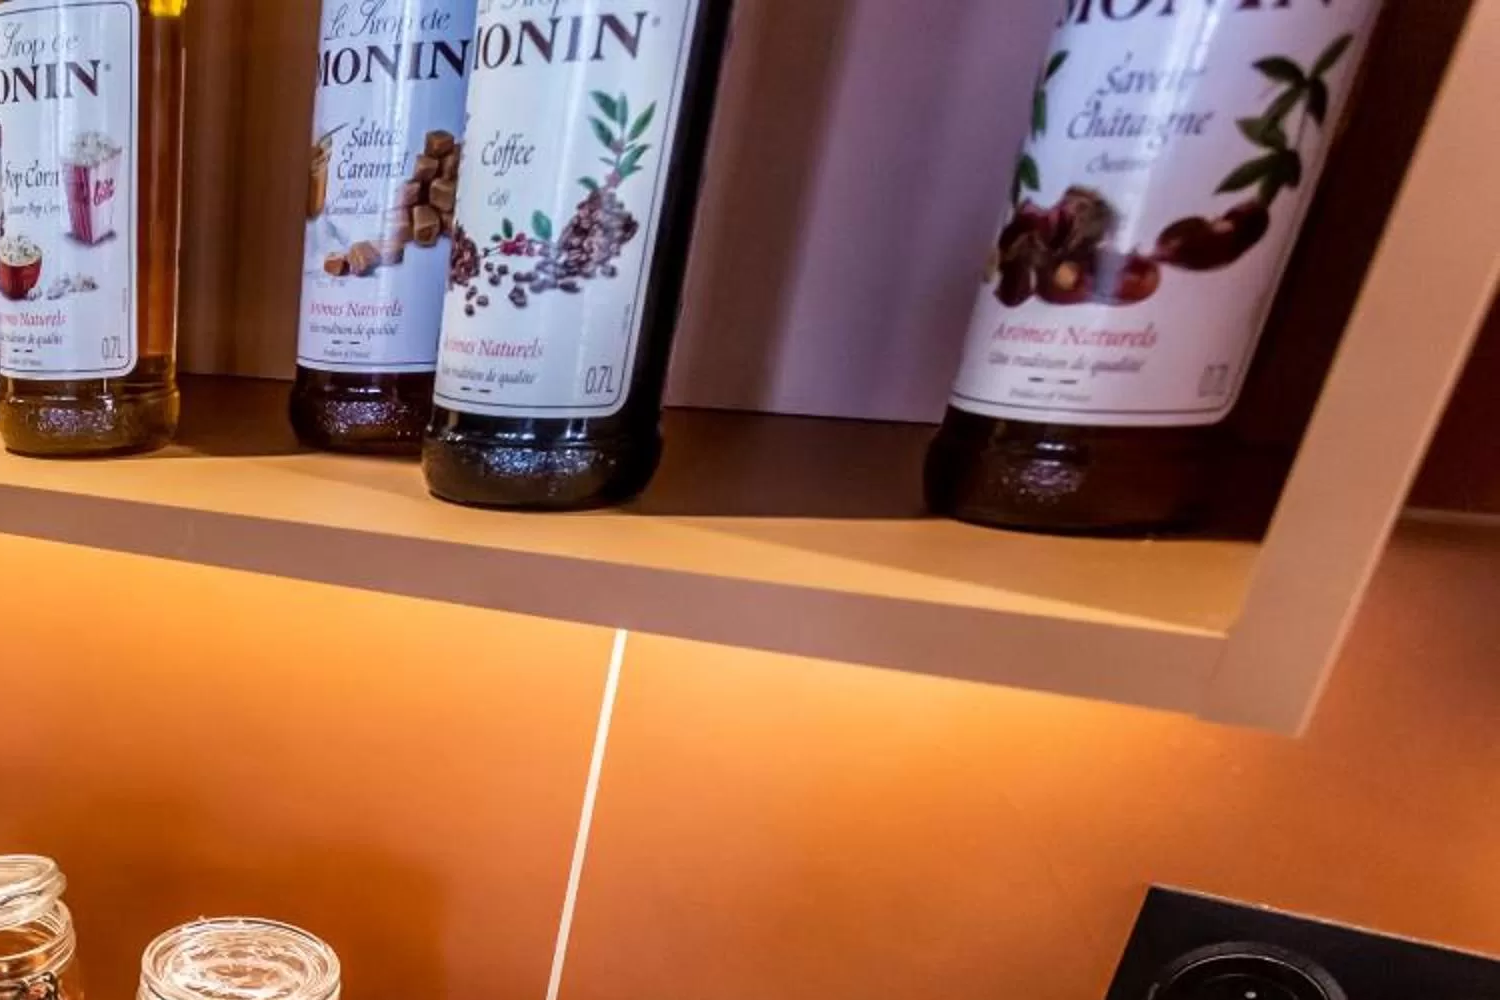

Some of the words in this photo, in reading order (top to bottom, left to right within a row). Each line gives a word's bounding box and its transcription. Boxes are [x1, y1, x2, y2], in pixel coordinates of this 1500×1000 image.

[420, 8, 450, 33] de
[474, 11, 648, 70] ONIN
[481, 130, 536, 177] Coffee
[477, 336, 544, 360] Naturels
